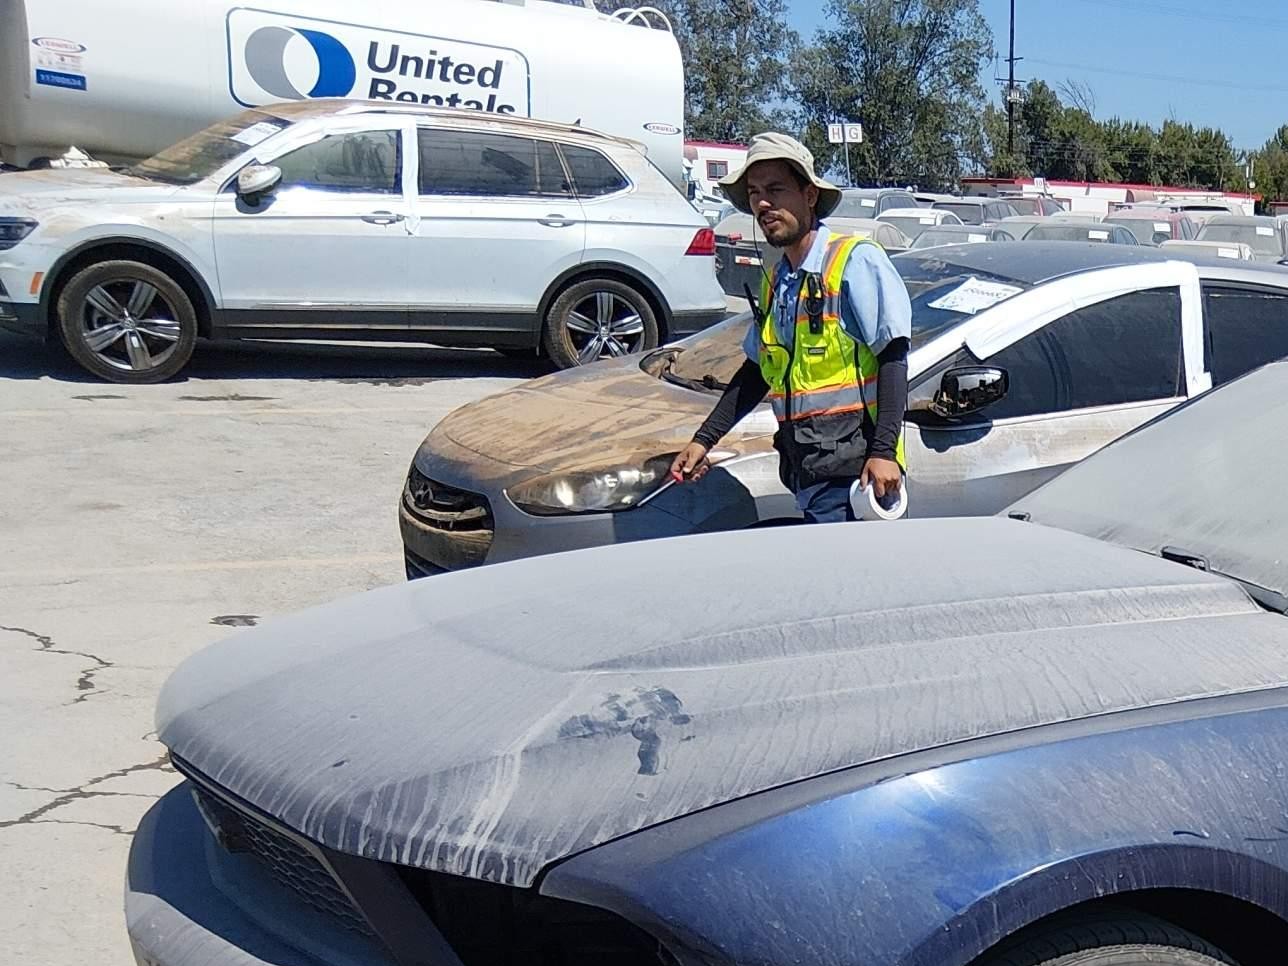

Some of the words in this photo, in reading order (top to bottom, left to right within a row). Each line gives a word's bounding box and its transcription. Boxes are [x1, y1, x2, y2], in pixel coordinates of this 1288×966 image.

[367, 41, 503, 89] United
[832, 127, 841, 140] H
[849, 127, 860, 140] G
